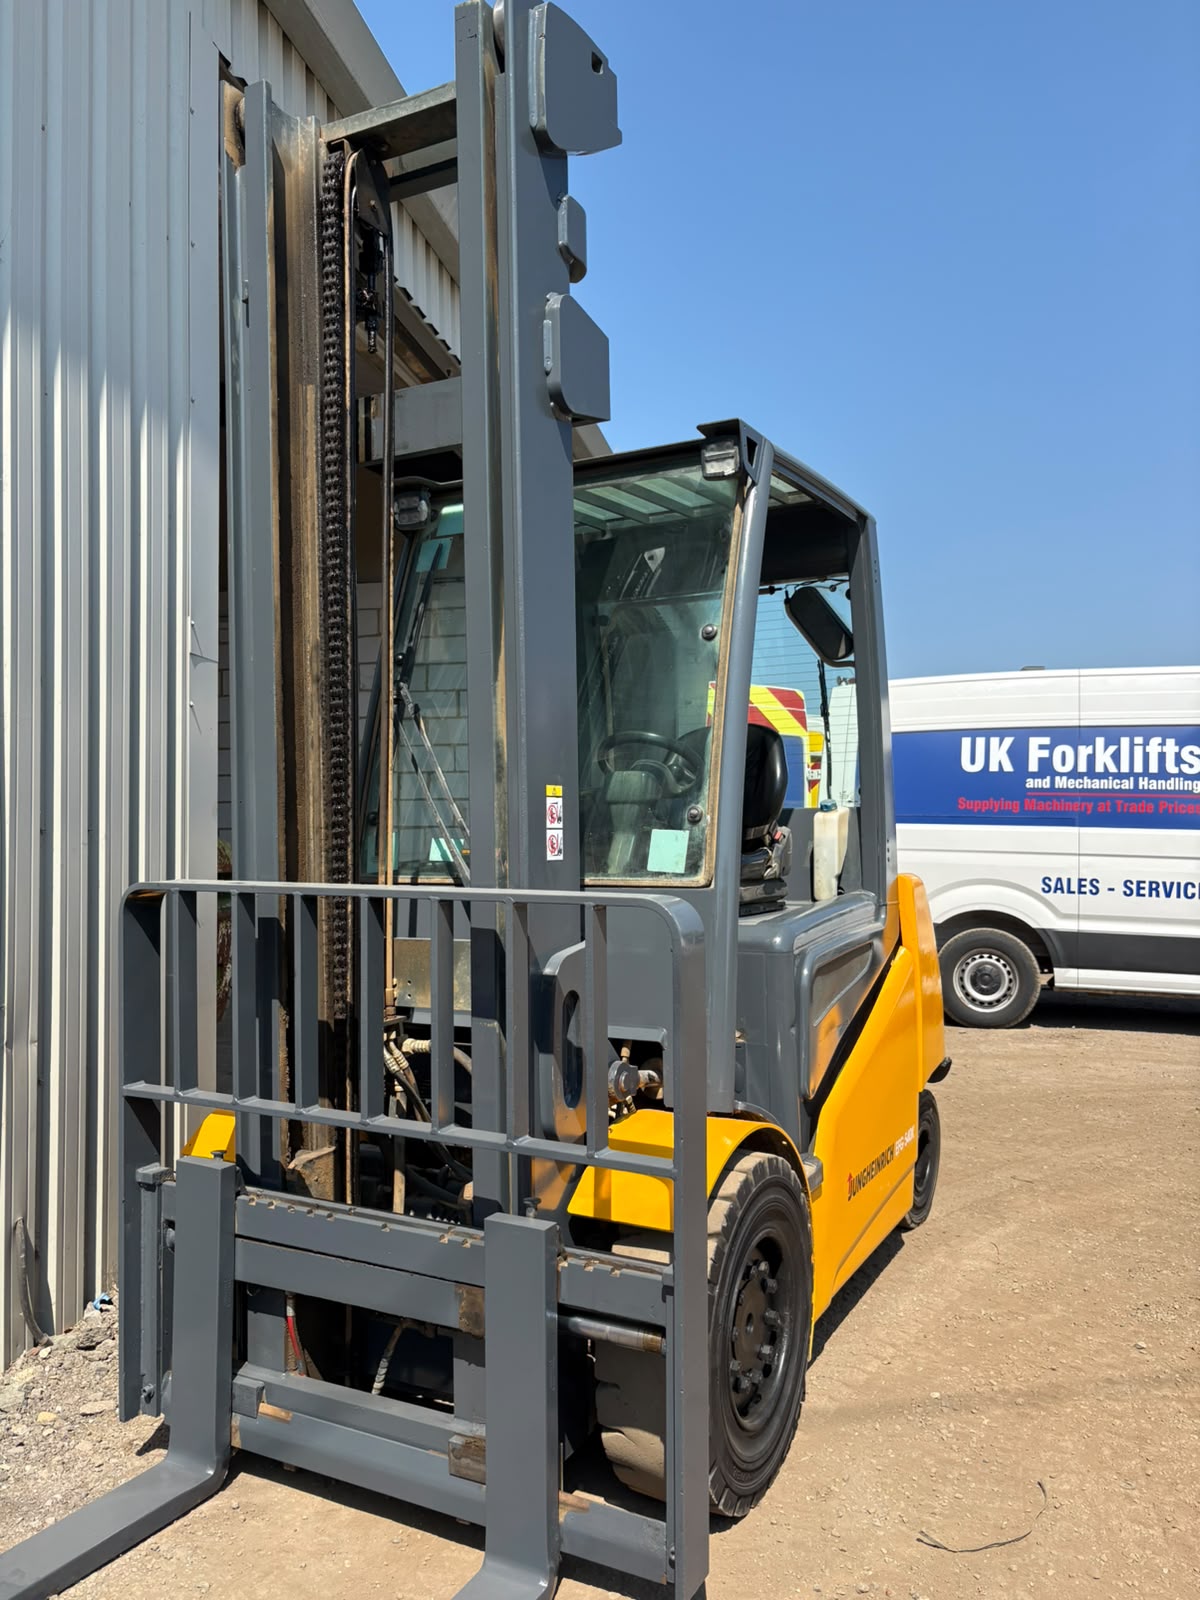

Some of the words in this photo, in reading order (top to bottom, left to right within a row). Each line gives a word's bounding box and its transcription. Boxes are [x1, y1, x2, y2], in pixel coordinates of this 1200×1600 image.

[961, 736, 1015, 773] UK
[1028, 736, 1200, 775] Forklifts
[1025, 776, 1051, 789] and
[1054, 776, 1134, 790] Mechanical
[1138, 776, 1200, 794] Handling
[957, 797, 1020, 814] Supplying
[1024, 798, 1093, 815] Machinery
[1096, 800, 1111, 813] at
[1115, 800, 1154, 814] Trade
[1041, 876, 1100, 896] SALES
[1123, 879, 1200, 900] SERVIC
[847, 1143, 895, 1202] JUNGHEINRICH
